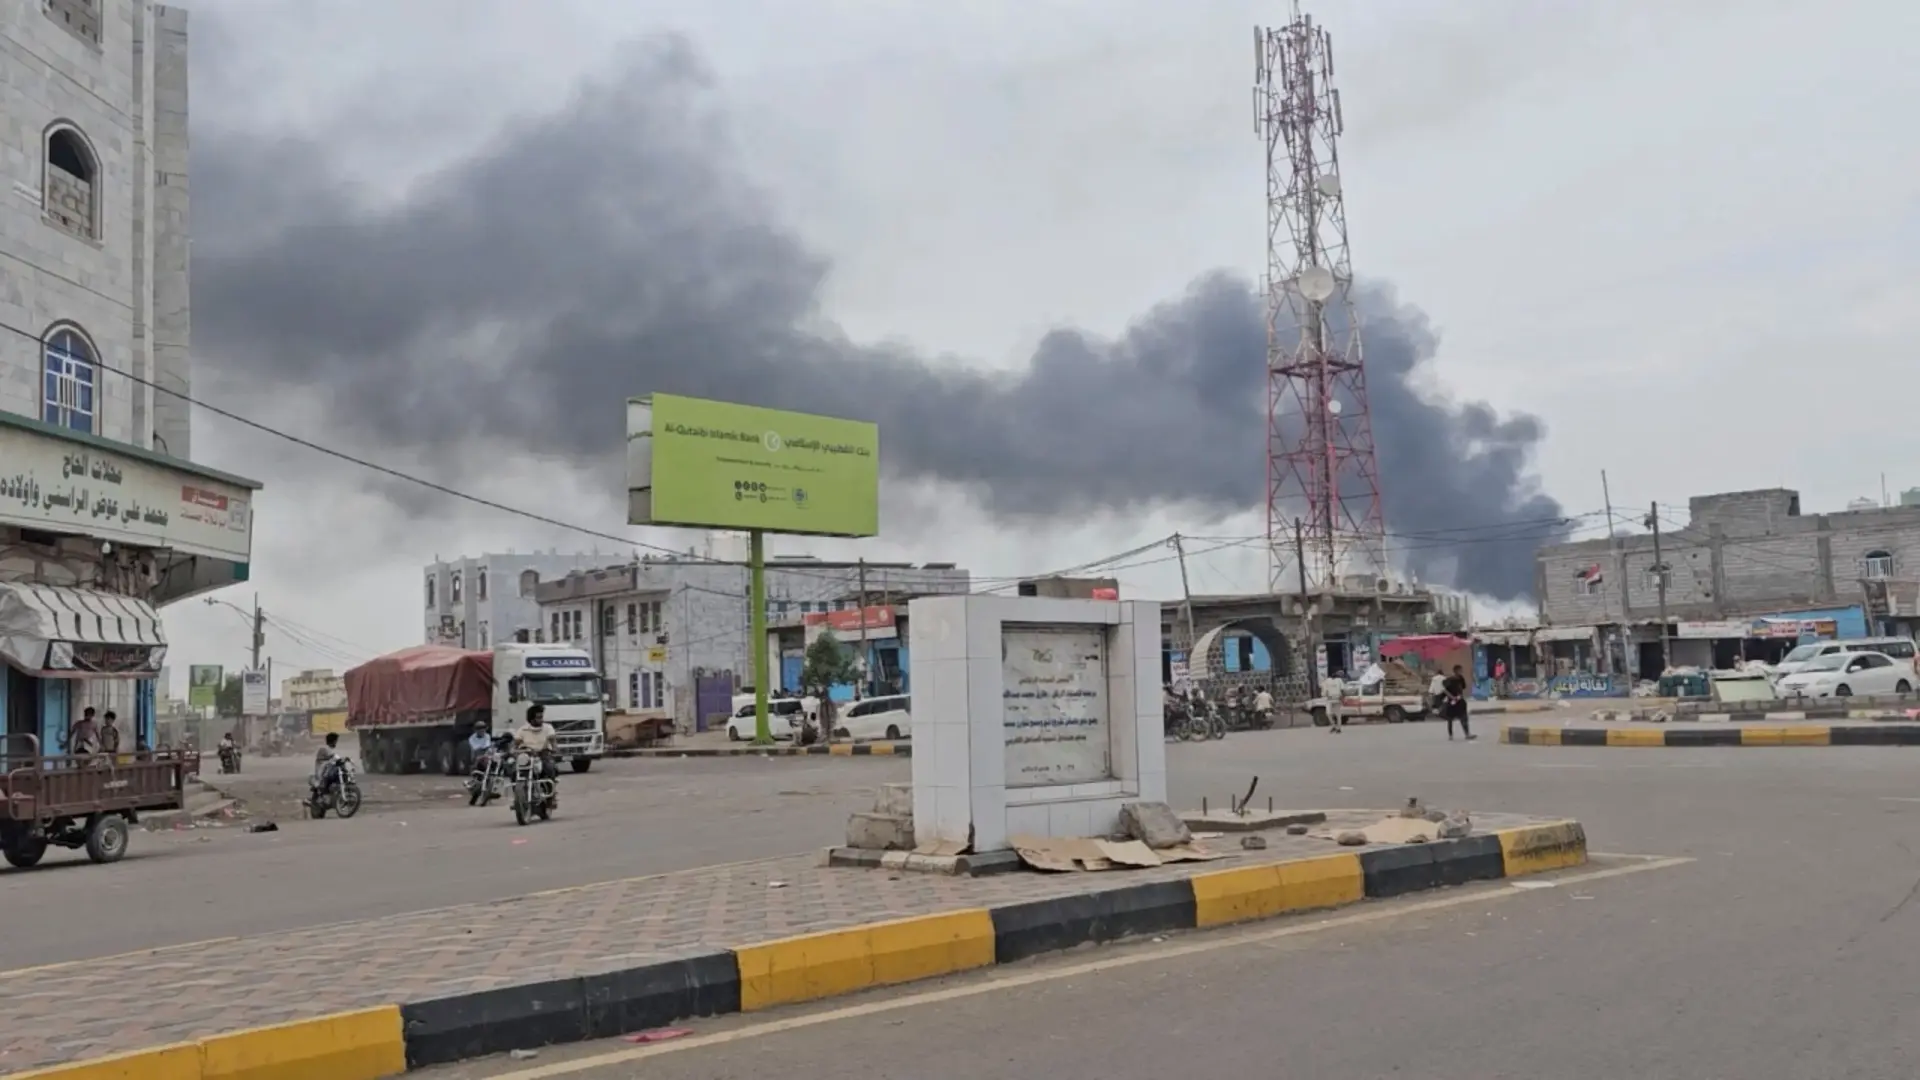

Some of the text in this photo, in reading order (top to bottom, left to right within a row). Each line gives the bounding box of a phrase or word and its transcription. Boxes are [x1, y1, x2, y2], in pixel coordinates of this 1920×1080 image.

[709, 428, 738, 441] Islamic
[740, 431, 760, 444] Bank
[62, 453, 123, 486] محلات الحاج
[121, 499, 140, 528] علي
[143, 507, 168, 527] محمد
